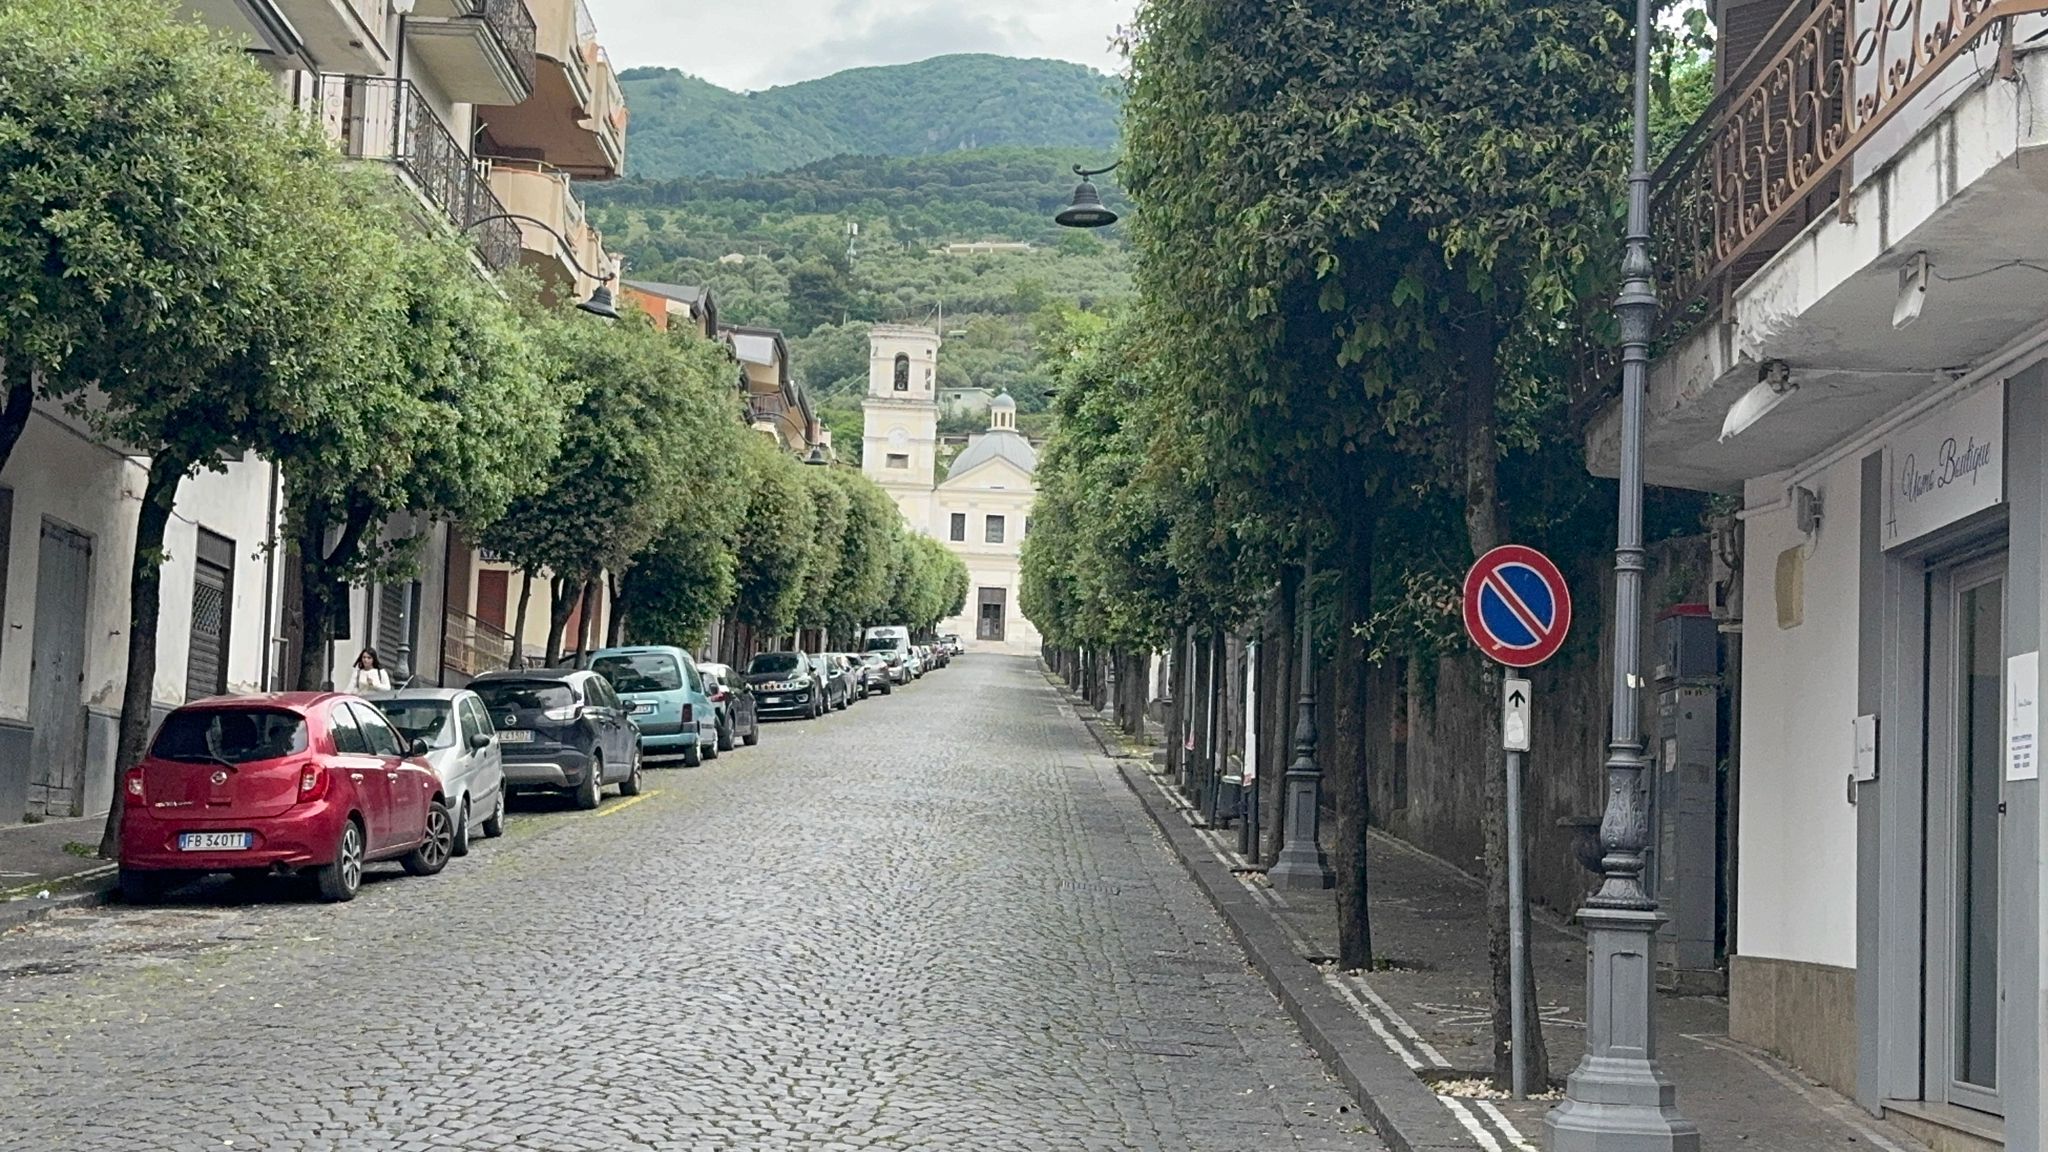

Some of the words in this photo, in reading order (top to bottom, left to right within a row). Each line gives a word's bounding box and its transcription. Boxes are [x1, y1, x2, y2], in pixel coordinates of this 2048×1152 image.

[1937, 436, 1990, 486] Boutique
[187, 835, 202, 847] FB
[206, 834, 243, 847] 340TT
